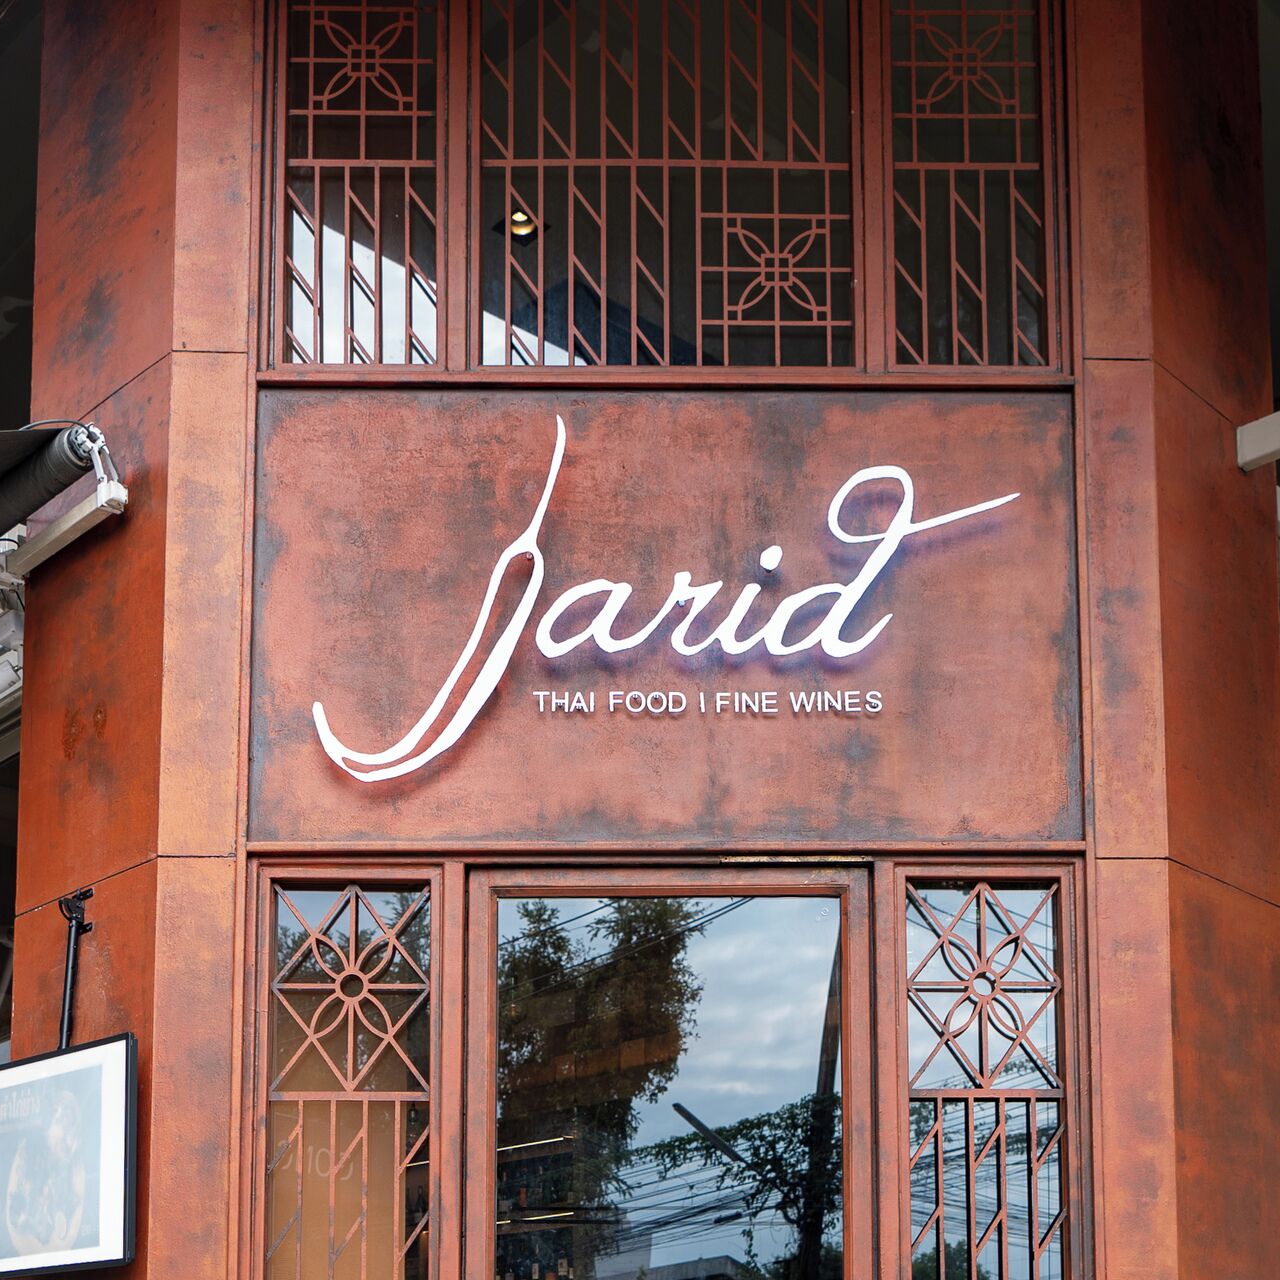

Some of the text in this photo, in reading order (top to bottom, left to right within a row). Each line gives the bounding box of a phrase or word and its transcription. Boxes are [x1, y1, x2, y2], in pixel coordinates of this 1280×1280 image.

[532, 691, 595, 713] THAI
[608, 690, 687, 713] FOOD
[716, 691, 779, 713] FINE
[789, 690, 883, 713] WINES
